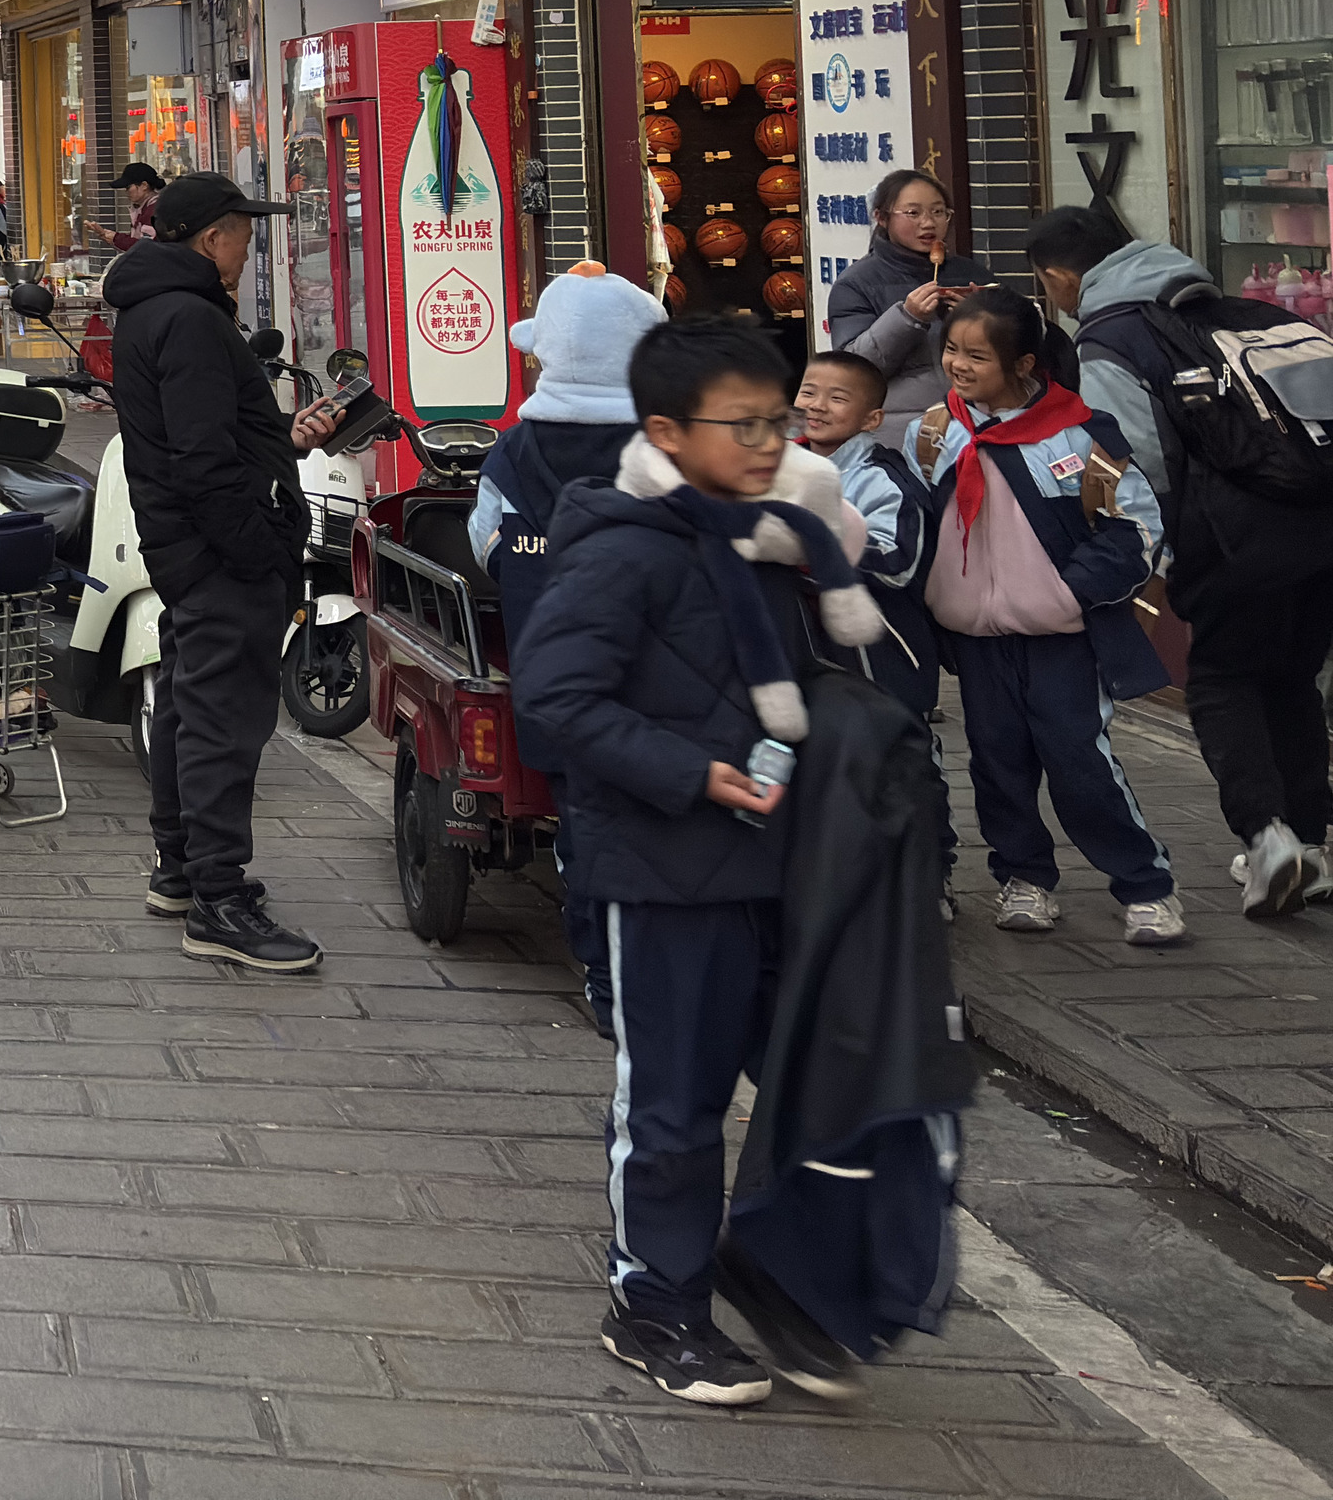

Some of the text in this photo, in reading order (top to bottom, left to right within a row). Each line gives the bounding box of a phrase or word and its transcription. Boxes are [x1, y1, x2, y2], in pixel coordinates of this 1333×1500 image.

[412, 219, 493, 241] 农夫山泉
[414, 240, 494, 253] NONGFU SPRING
[436, 288, 475, 301] 每一滴
[430, 302, 482, 315] 农夫山泉
[430, 315, 483, 329] 都有优质
[437, 329, 477, 343] 的水源
